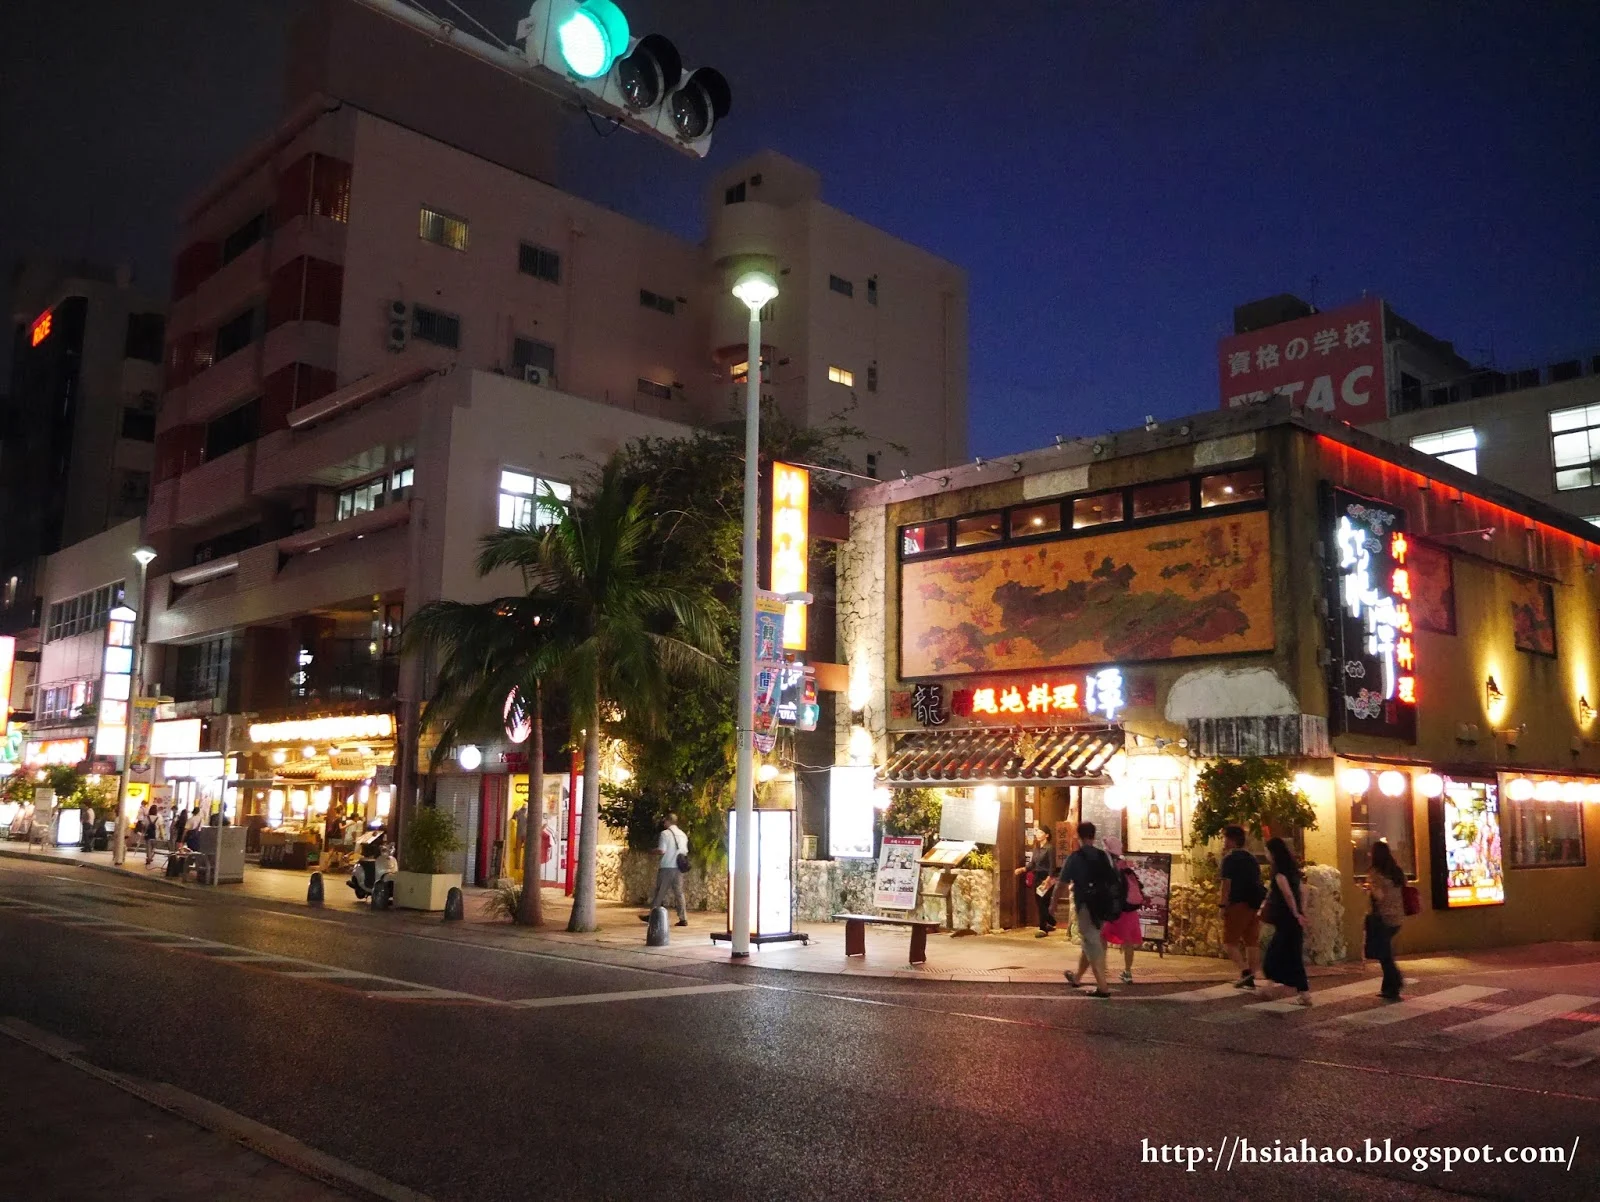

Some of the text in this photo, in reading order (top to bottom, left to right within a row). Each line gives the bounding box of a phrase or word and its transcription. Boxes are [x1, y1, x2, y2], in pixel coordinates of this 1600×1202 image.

[1228, 320, 1370, 378] 資格の学校
